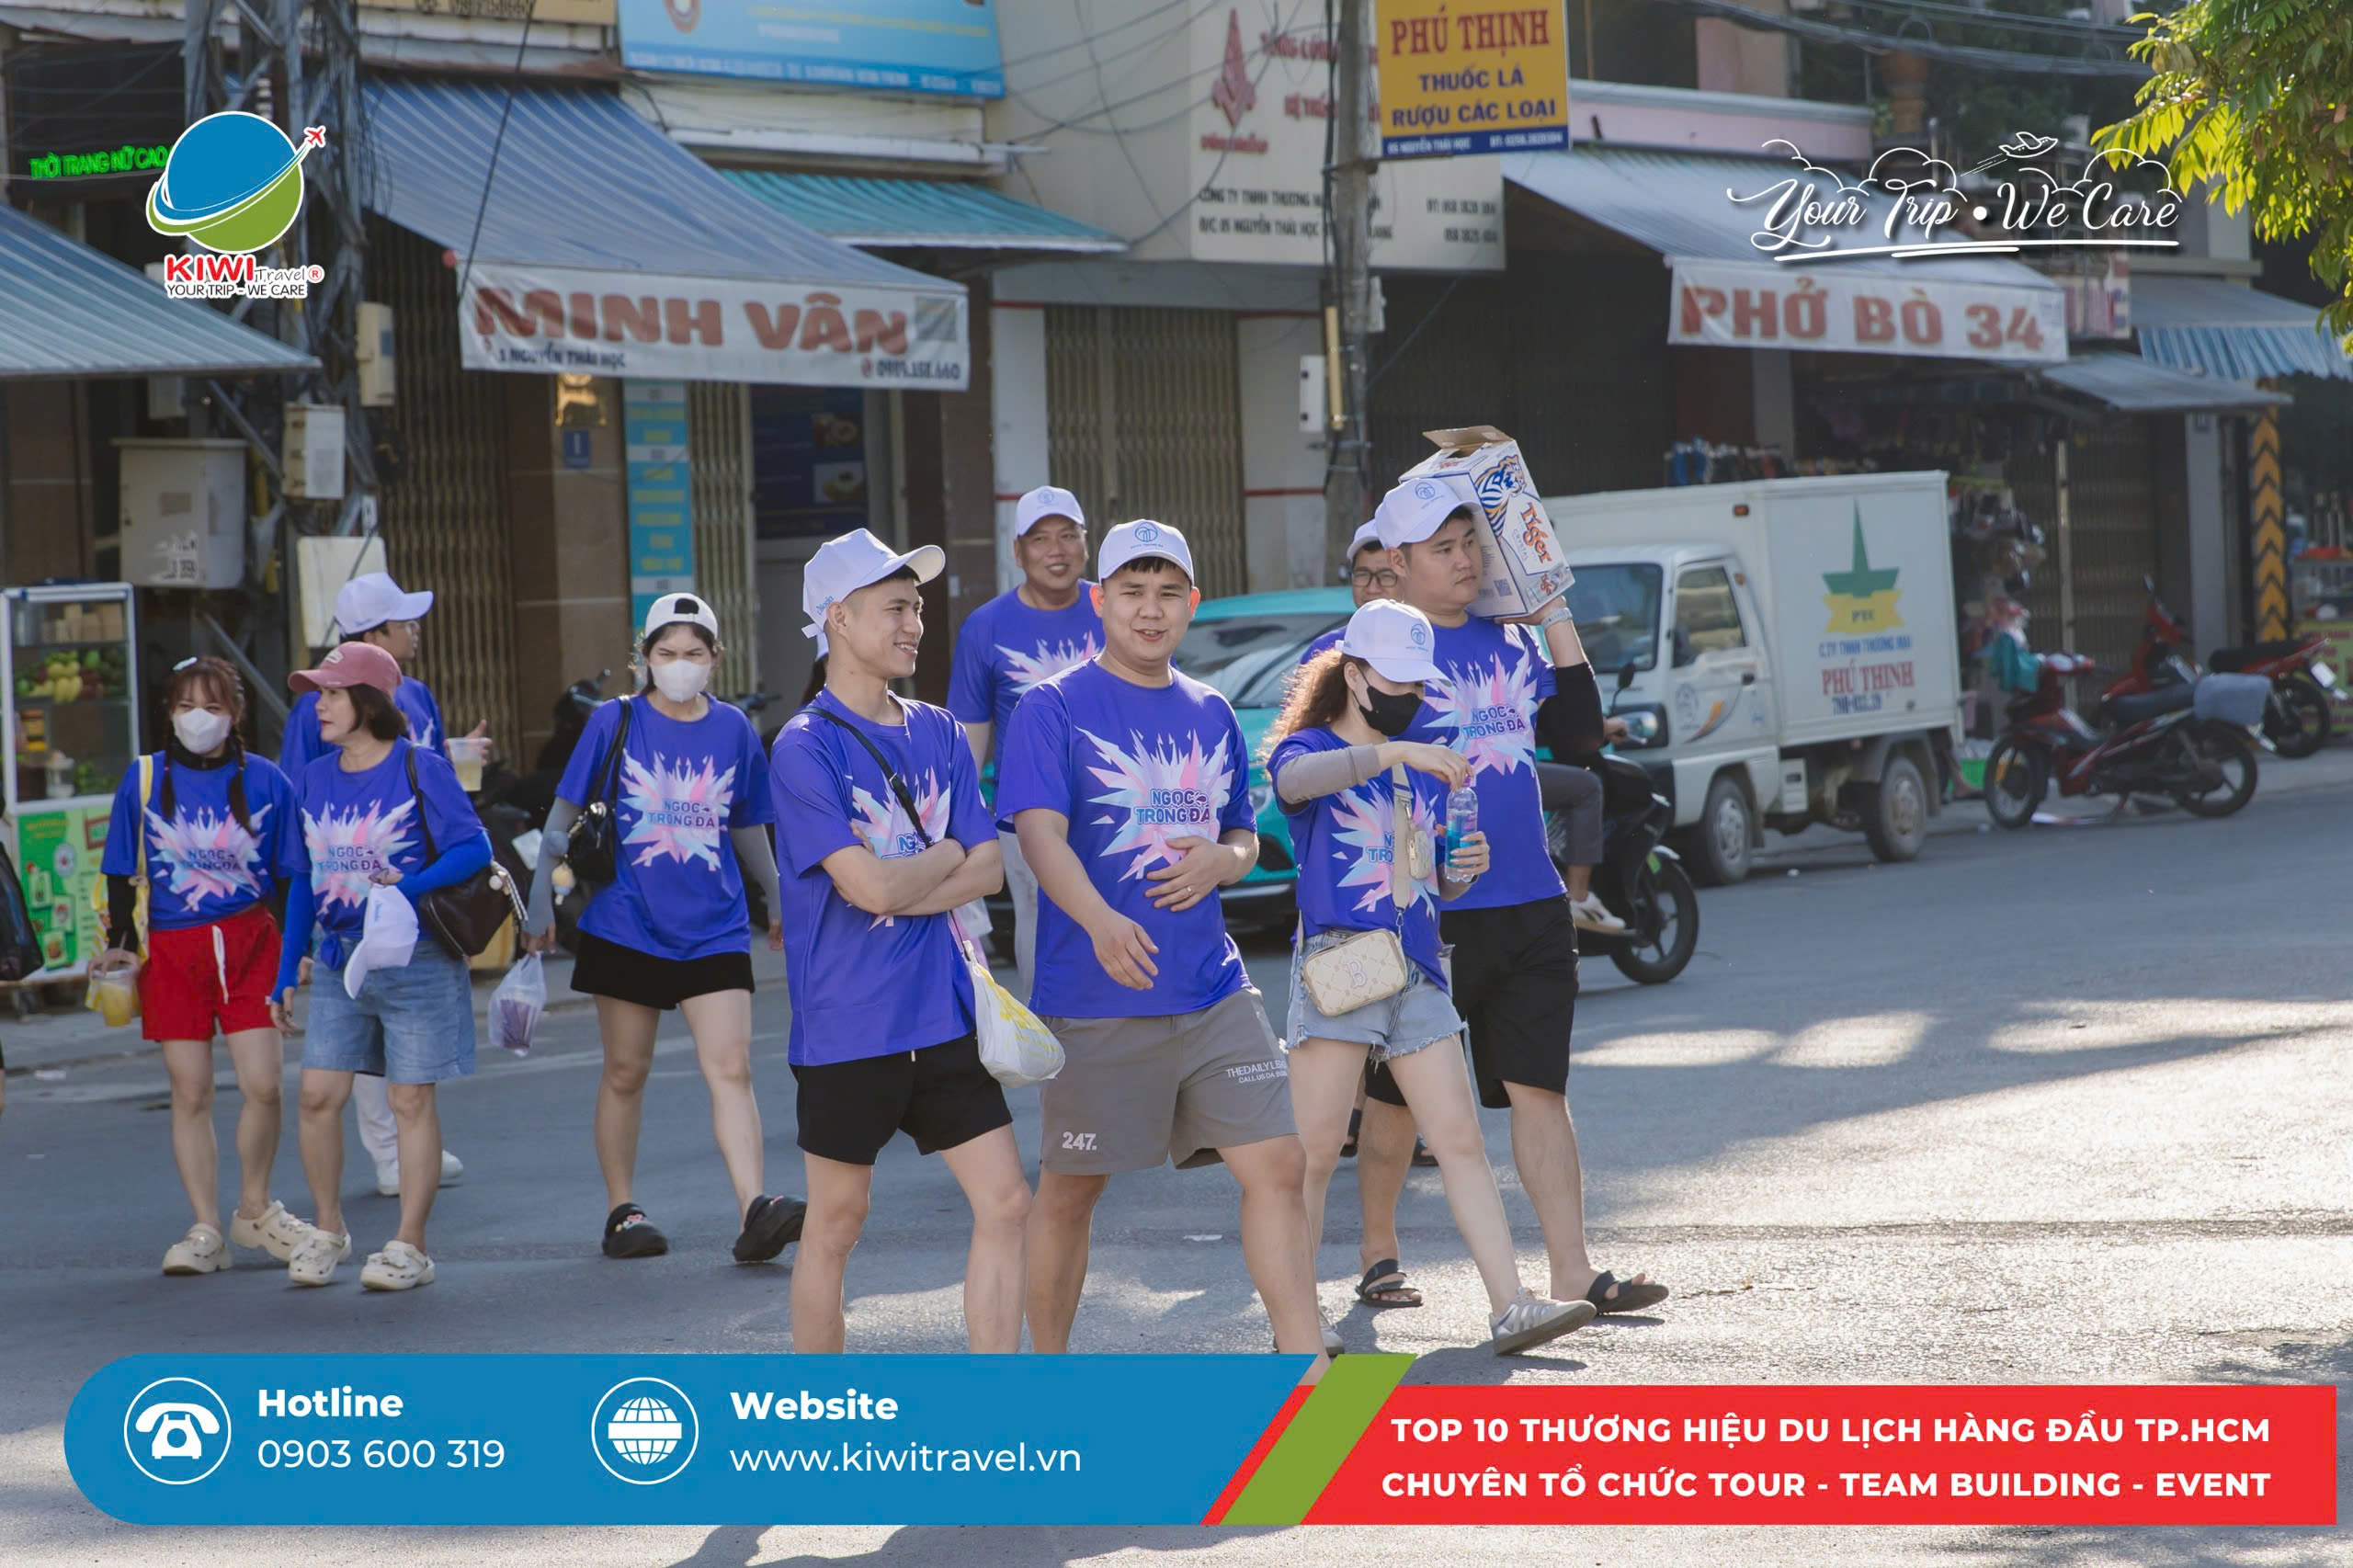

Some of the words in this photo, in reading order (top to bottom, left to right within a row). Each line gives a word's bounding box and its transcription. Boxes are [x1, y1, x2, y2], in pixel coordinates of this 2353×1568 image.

[1391, 5, 1449, 55] PHÚ
[1457, 10, 1550, 58] THỊNH
[1419, 64, 1489, 92] THUỐC
[1497, 62, 1524, 87] LÁ
[1392, 105, 1450, 129] RƯỢU
[1457, 100, 1499, 123] CÁC
[1506, 98, 1556, 122] LOẠI
[474, 287, 724, 345] MINH
[743, 291, 909, 357] VÂN
[1680, 277, 1828, 340] PHỞ
[1853, 287, 1944, 347] BÒ
[1965, 302, 2046, 351] 34
[1520, 502, 1553, 564] Tiger
[1822, 658, 1855, 697] PHÚ
[1860, 661, 1915, 699] THỊNH
[648, 812, 692, 827] TRONG
[1136, 808, 1187, 824] TRONG
[1062, 1131, 1097, 1151] 247.
